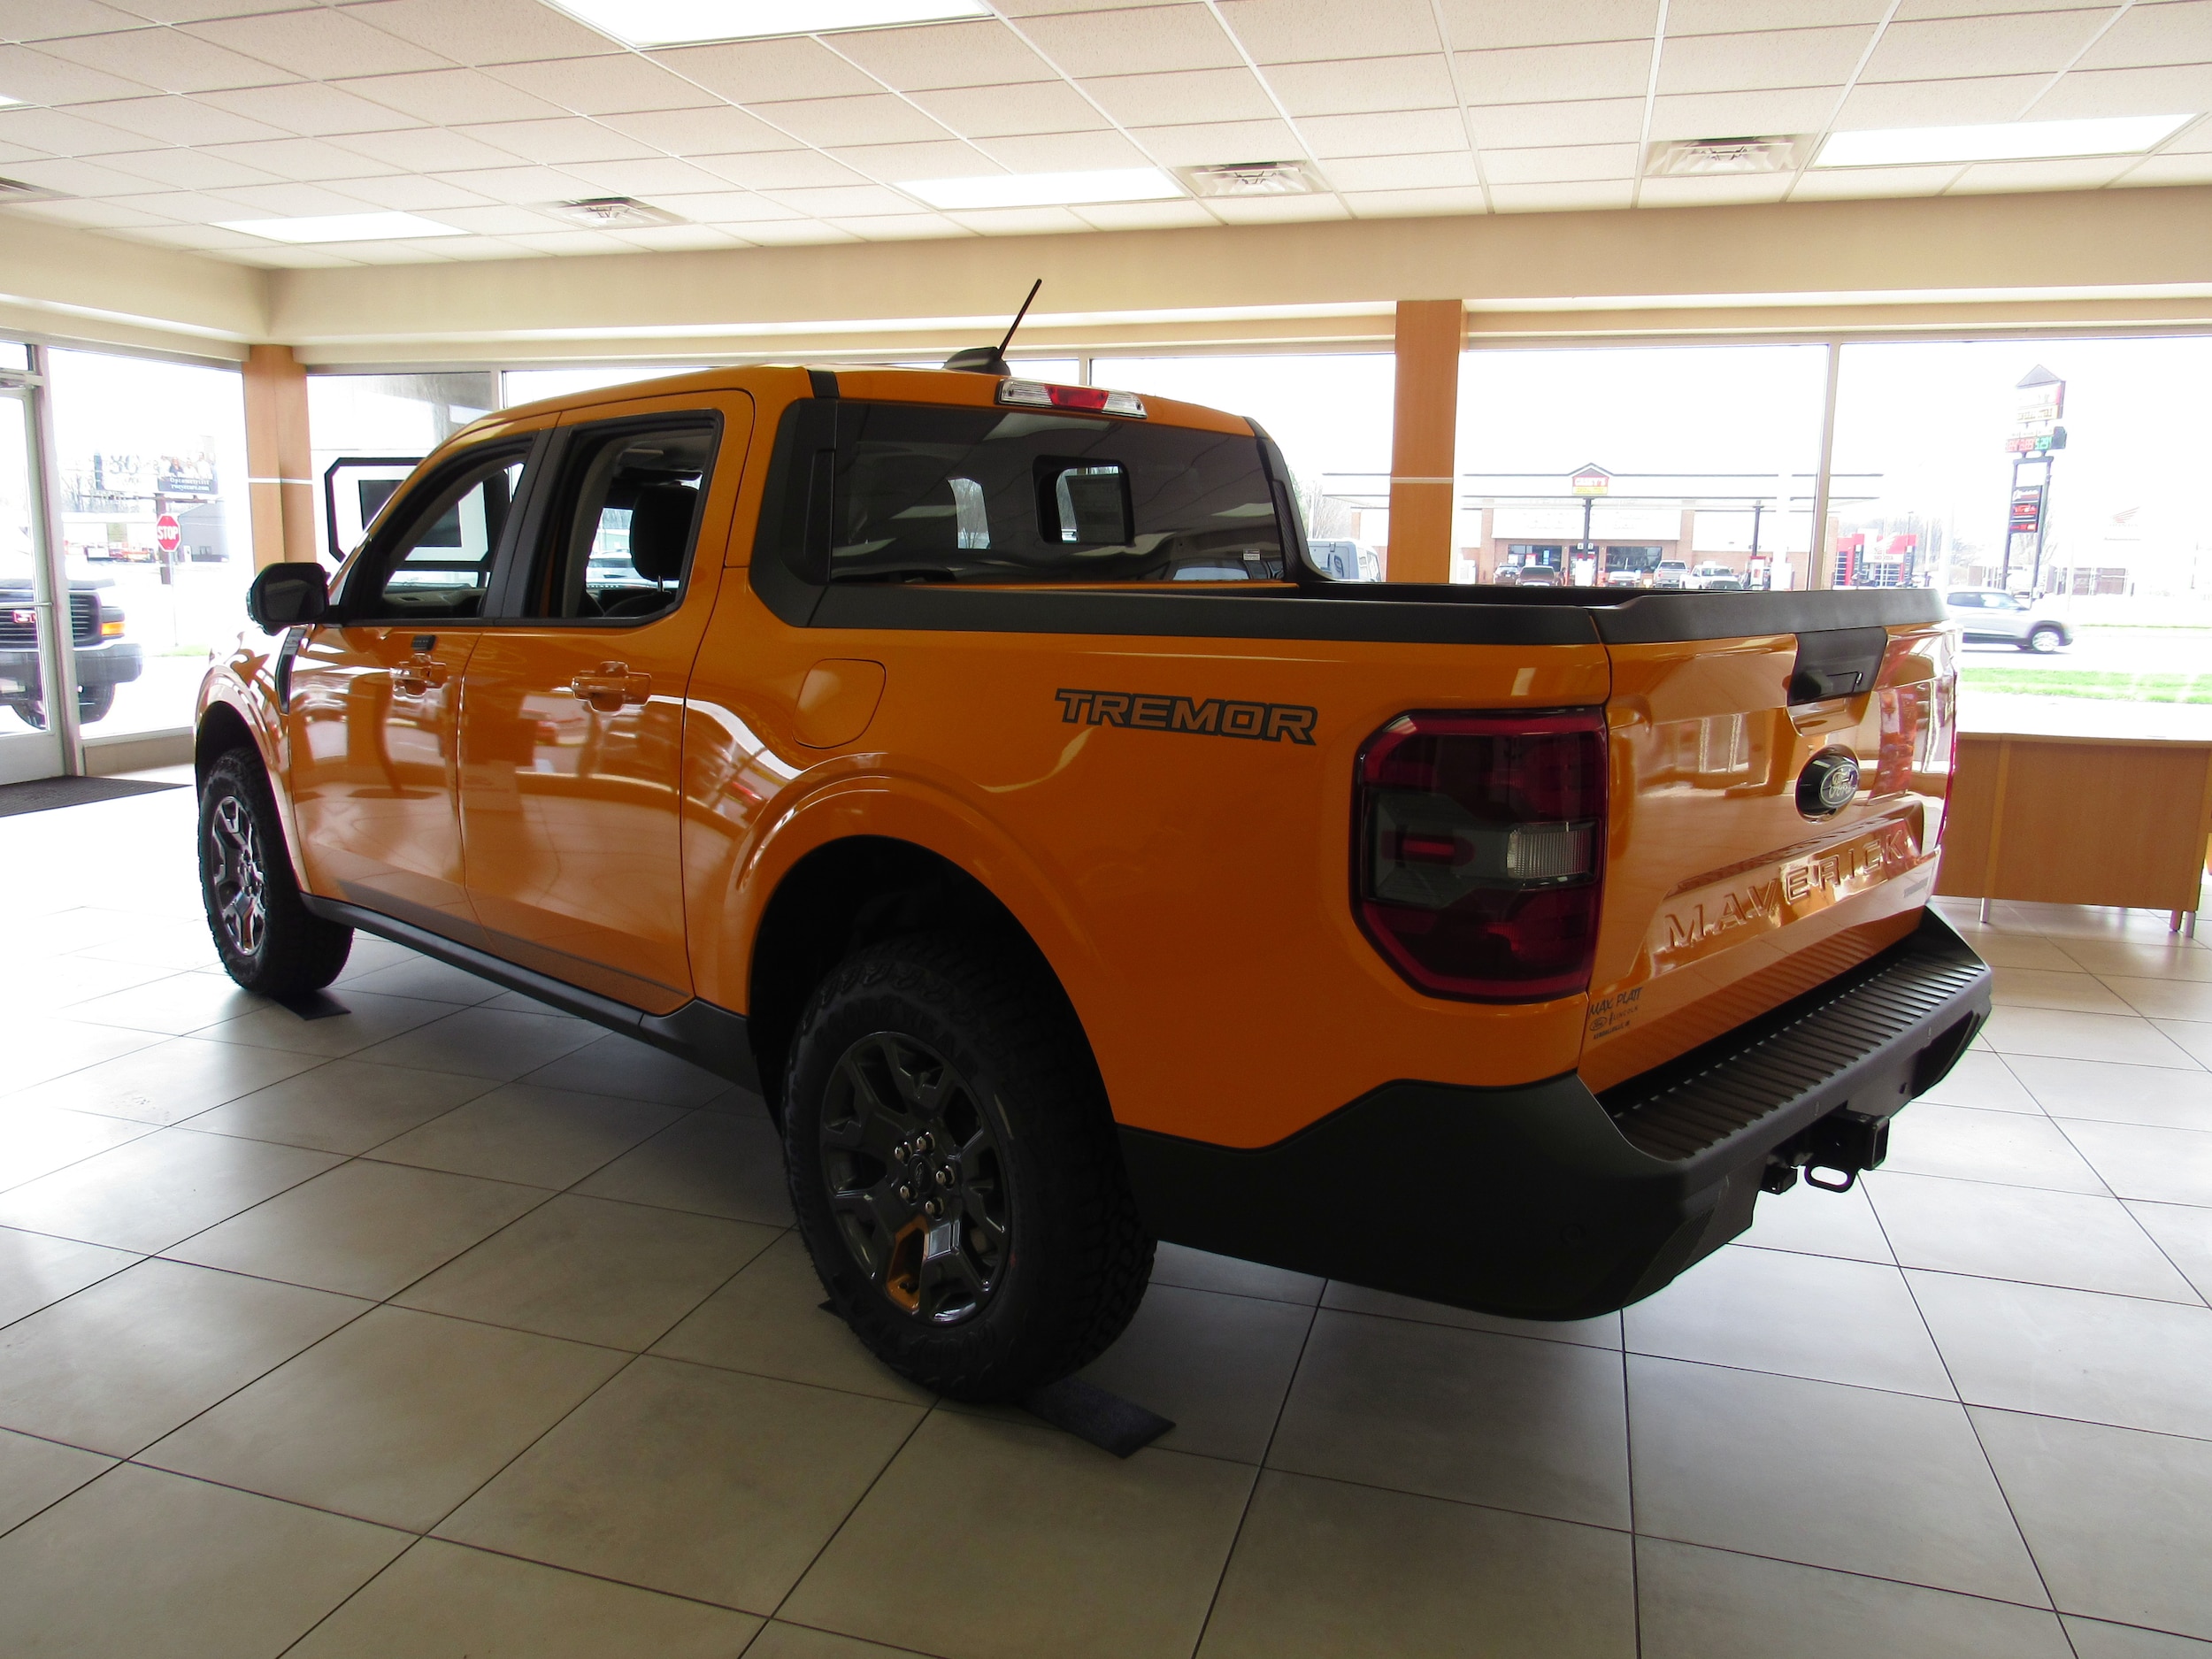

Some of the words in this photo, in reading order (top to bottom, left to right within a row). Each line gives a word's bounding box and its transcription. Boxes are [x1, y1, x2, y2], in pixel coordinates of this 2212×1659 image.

[157, 526, 180, 541] STOP
[1055, 688, 1318, 746] TREMOR
[1662, 829, 1905, 949] MAVERICK
[1588, 998, 1614, 1019] MAX
[1616, 987, 1643, 1006] PLATT
